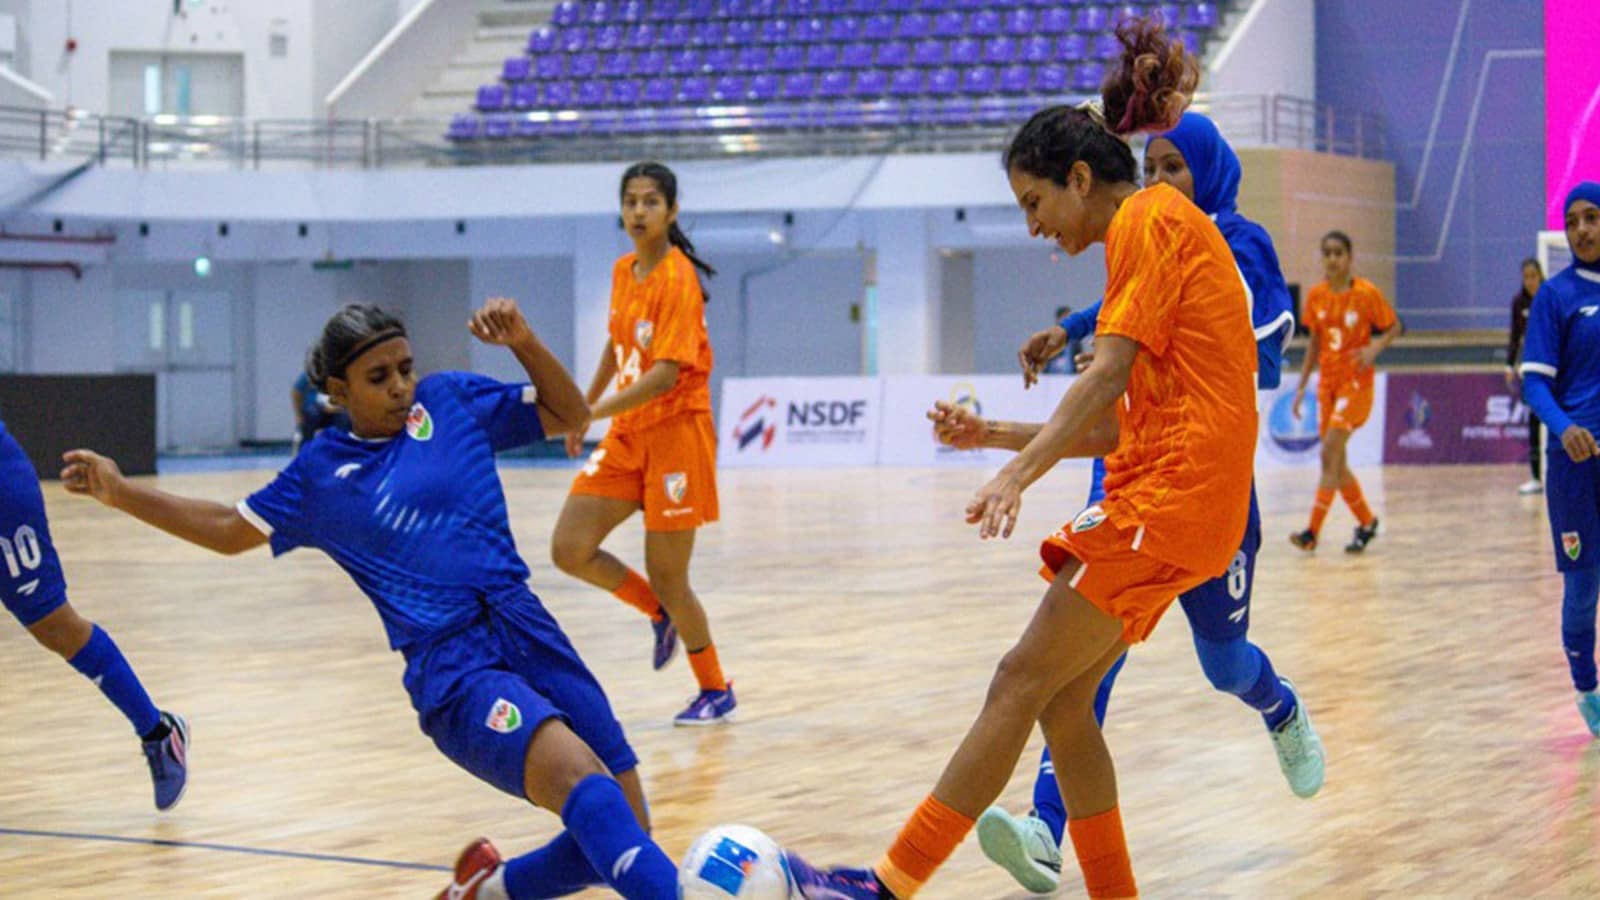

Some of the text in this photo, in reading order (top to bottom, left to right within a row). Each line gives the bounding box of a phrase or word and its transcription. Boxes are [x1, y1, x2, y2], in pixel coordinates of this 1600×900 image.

[1328, 327, 1342, 351] 3
[614, 344, 641, 384] 14
[786, 400, 867, 426] NSDF
[0, 524, 41, 578] 10
[1227, 550, 1246, 600] 8
